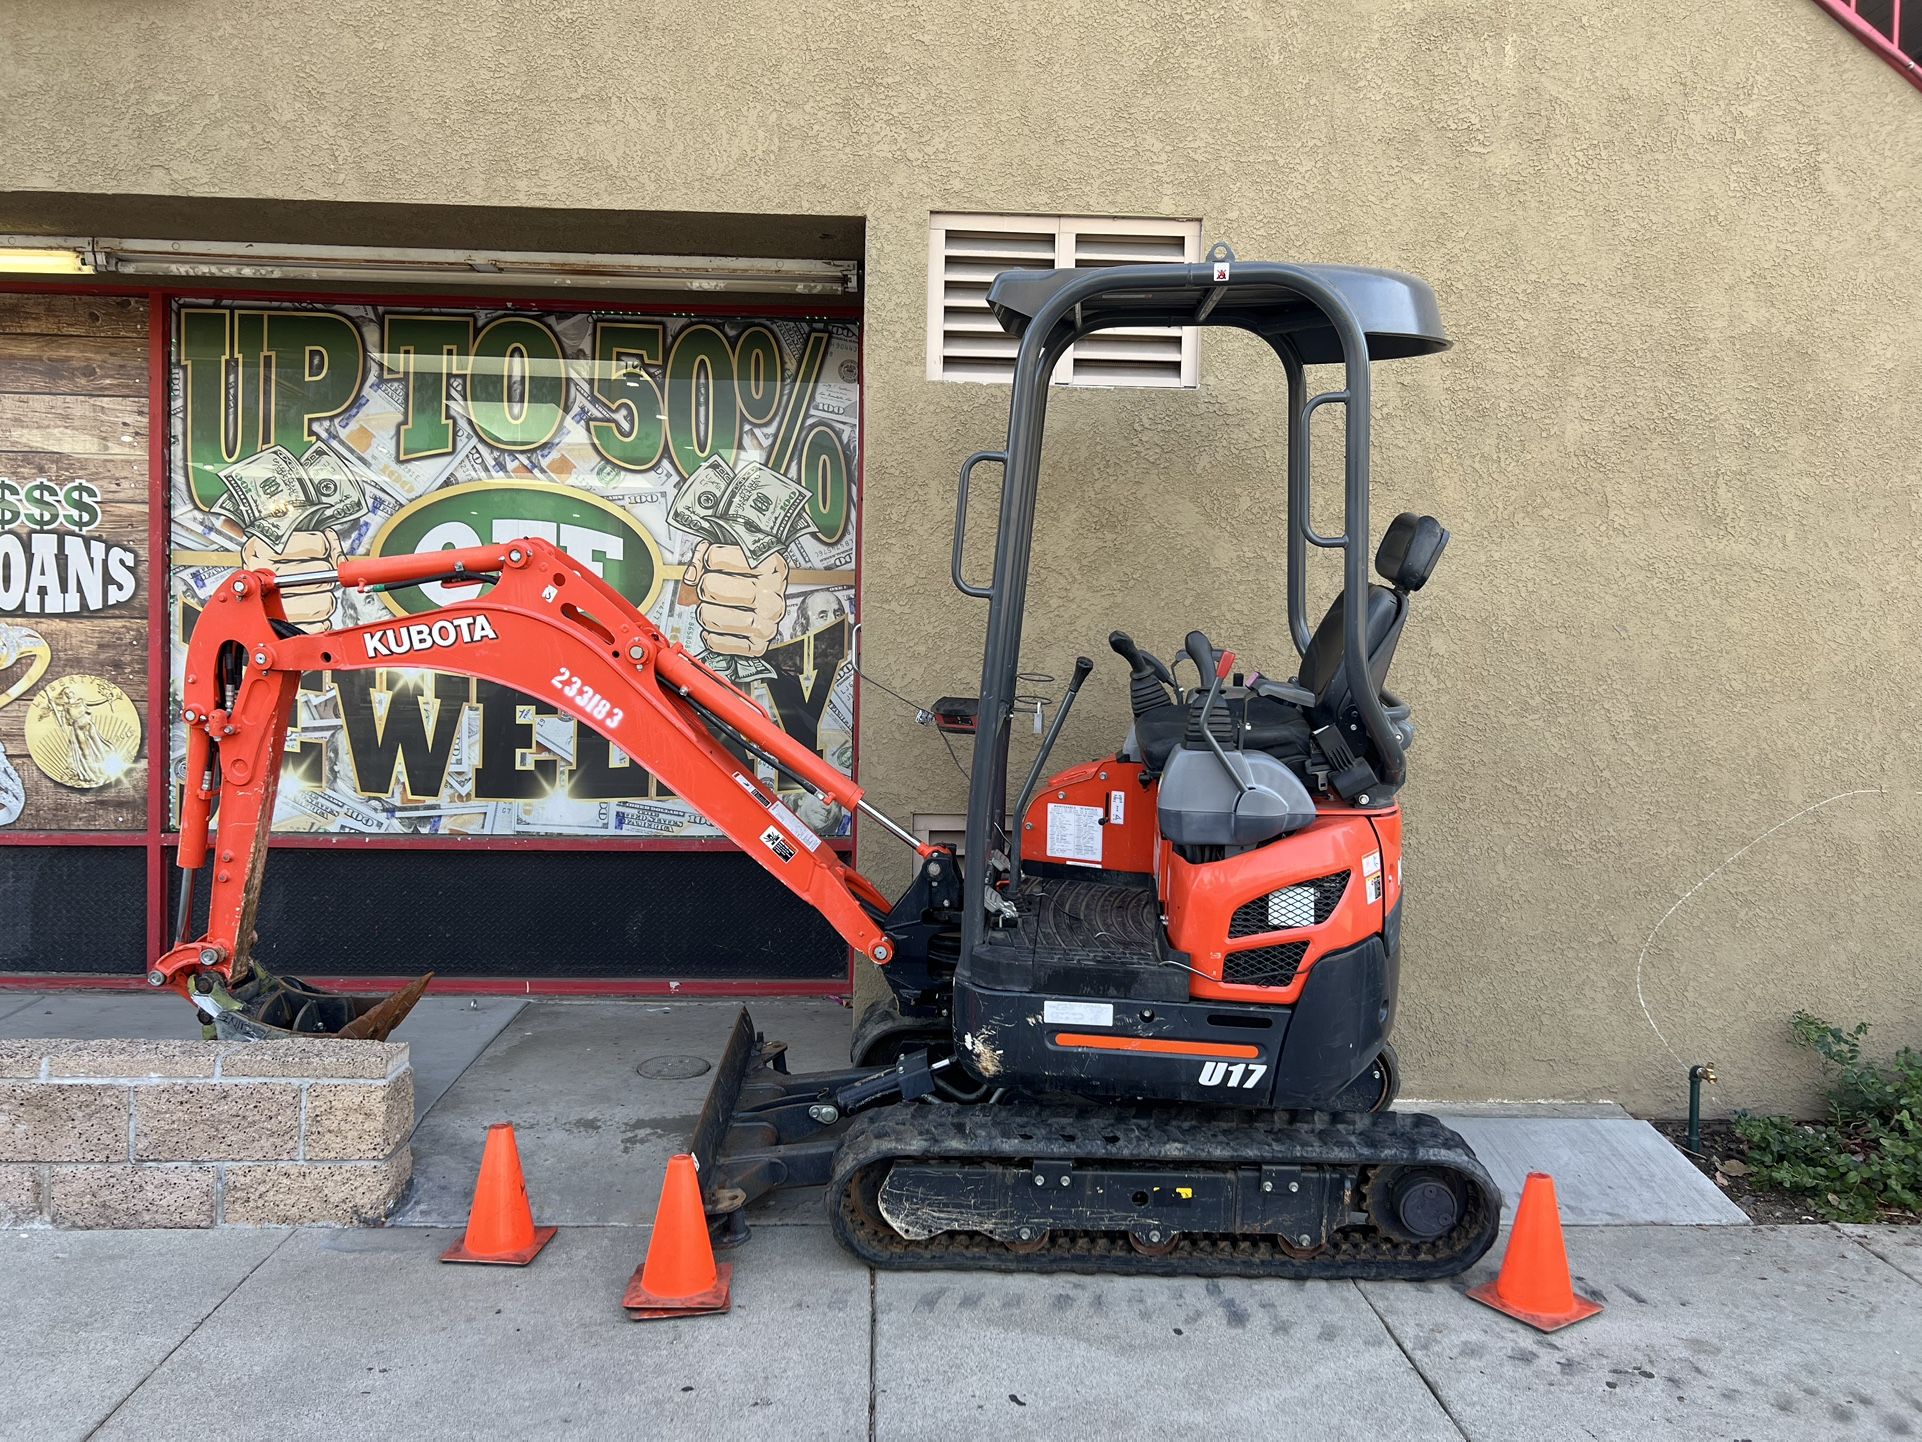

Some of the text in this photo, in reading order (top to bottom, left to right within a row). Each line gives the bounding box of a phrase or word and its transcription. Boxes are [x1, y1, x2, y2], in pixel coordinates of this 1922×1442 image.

[182, 309, 848, 544] UP TO 50%
[363, 614, 498, 658] KUBOTA
[550, 667, 624, 729] 233183
[1198, 1061, 1268, 1089] U17
